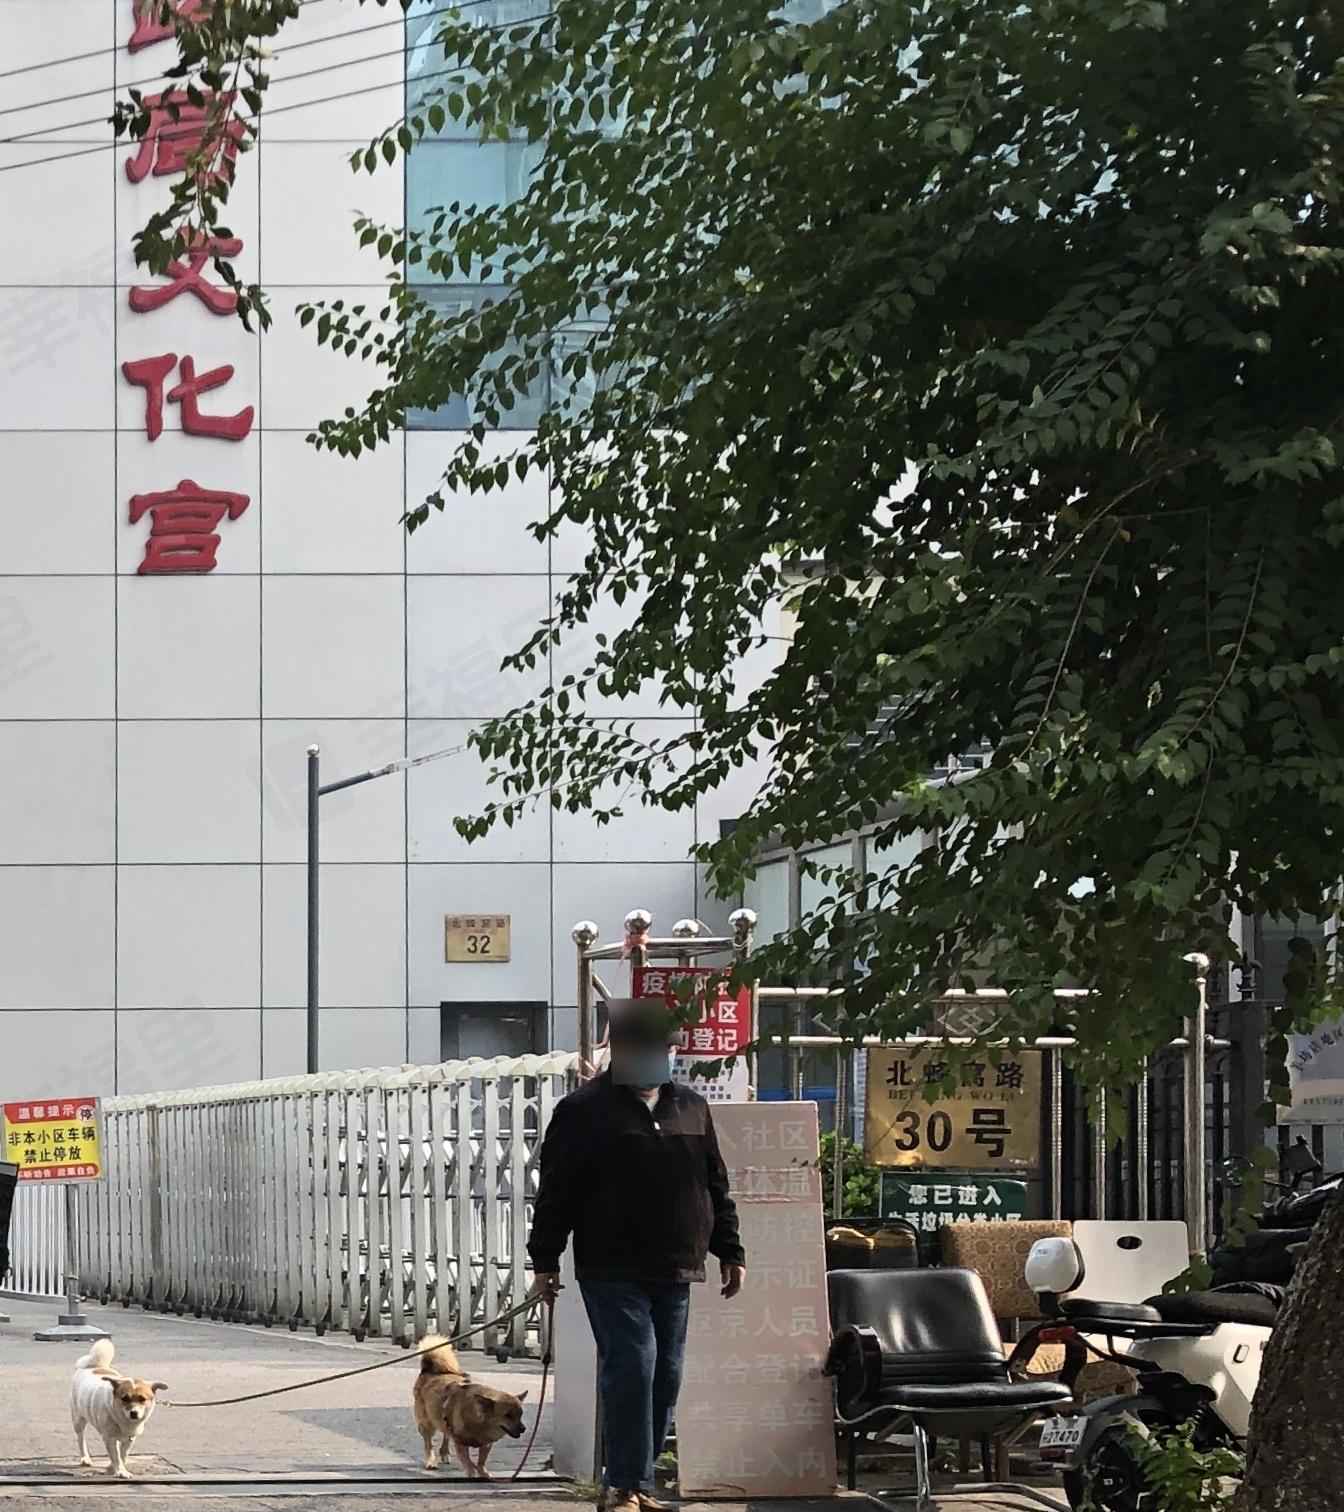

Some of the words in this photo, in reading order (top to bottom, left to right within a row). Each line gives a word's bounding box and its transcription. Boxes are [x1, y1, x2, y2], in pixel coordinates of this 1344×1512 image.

[467, 935, 491, 954] 32
[8, 1127, 95, 1146] 非本小区车辆
[24, 1146, 81, 1163] 禁止停放
[908, 1184, 1002, 1206] 您已进入
